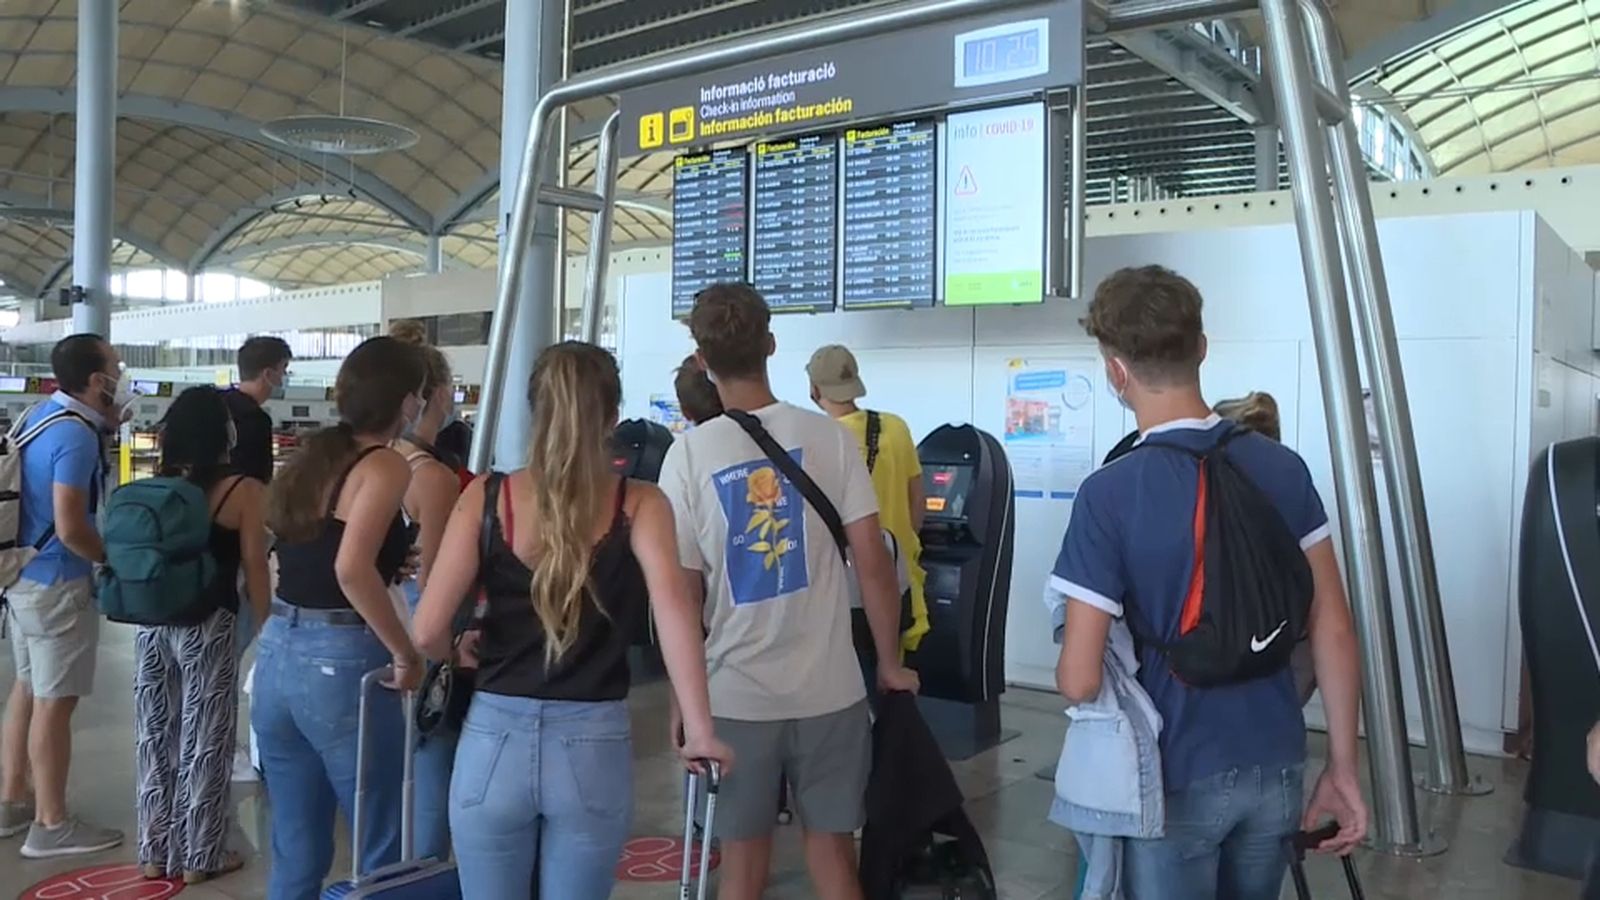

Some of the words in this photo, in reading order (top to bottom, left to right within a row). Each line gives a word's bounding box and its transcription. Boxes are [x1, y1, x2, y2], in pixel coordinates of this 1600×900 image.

[700, 77, 765, 102] Informació
[768, 61, 836, 92] facturació
[700, 99, 740, 119] Check-in
[740, 90, 796, 110] information
[700, 111, 773, 136] Información
[775, 98, 853, 124] facturación
[954, 124, 977, 141] info
[985, 118, 1034, 136] COVID-19
